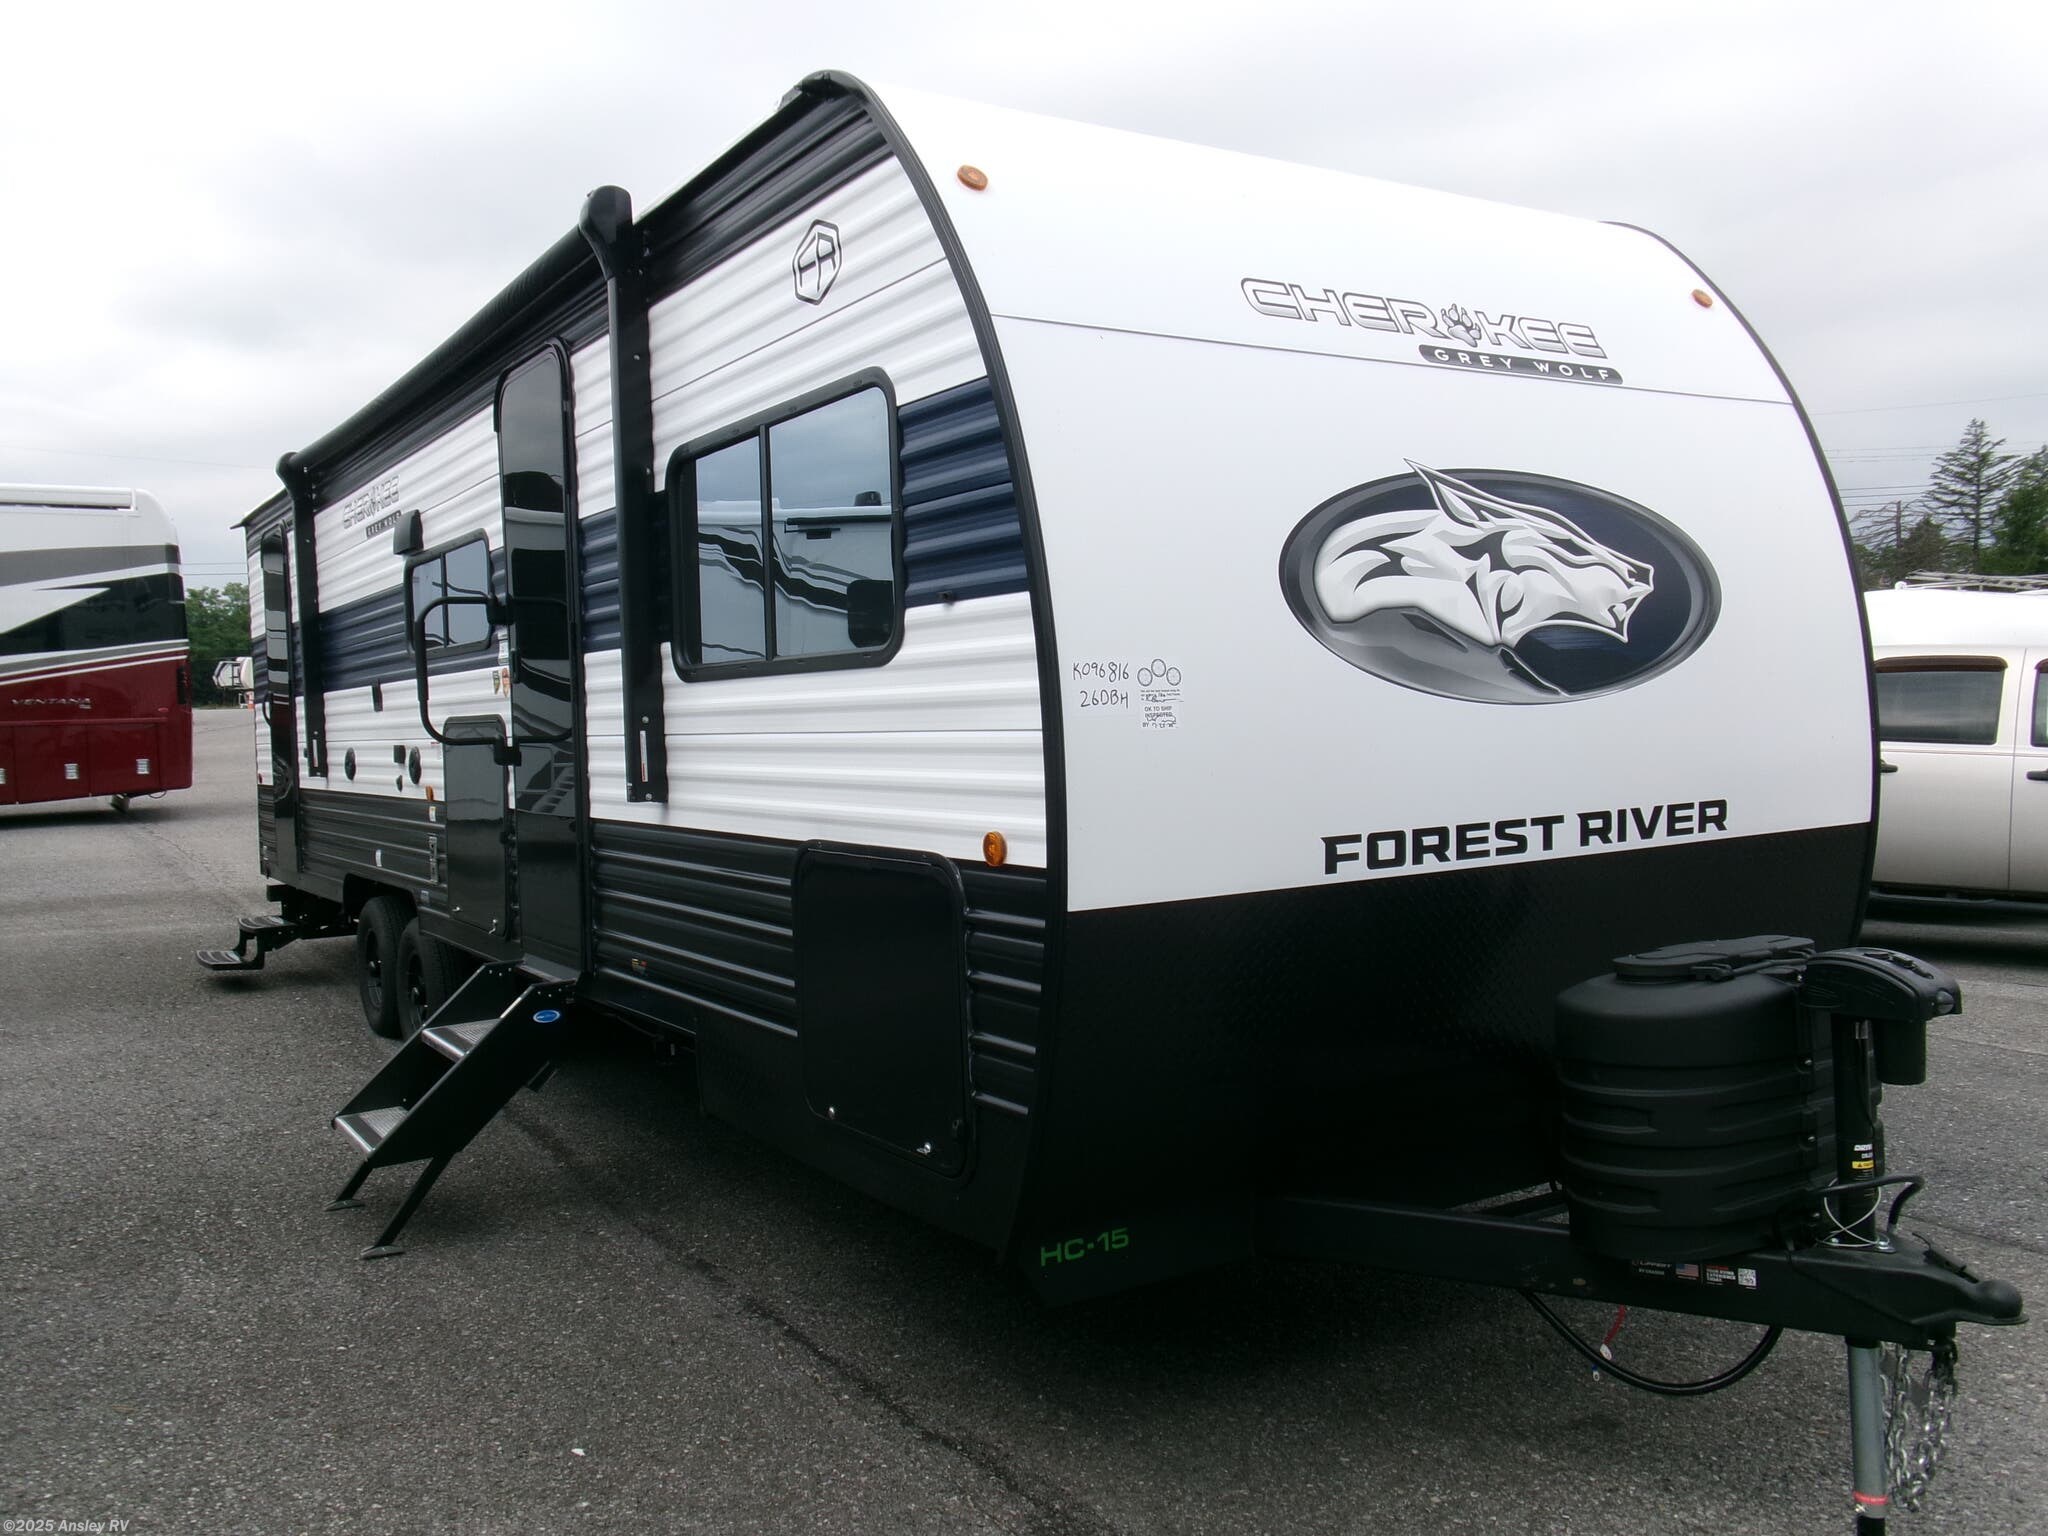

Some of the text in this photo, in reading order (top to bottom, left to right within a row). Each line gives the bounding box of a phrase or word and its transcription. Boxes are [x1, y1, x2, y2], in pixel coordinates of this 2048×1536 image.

[1434, 349, 1609, 382] GREY WOLF
[1073, 661, 1129, 683] K096816
[1080, 689, 1129, 709] 26DBH
[1319, 798, 1728, 875] FOREST RIVER
